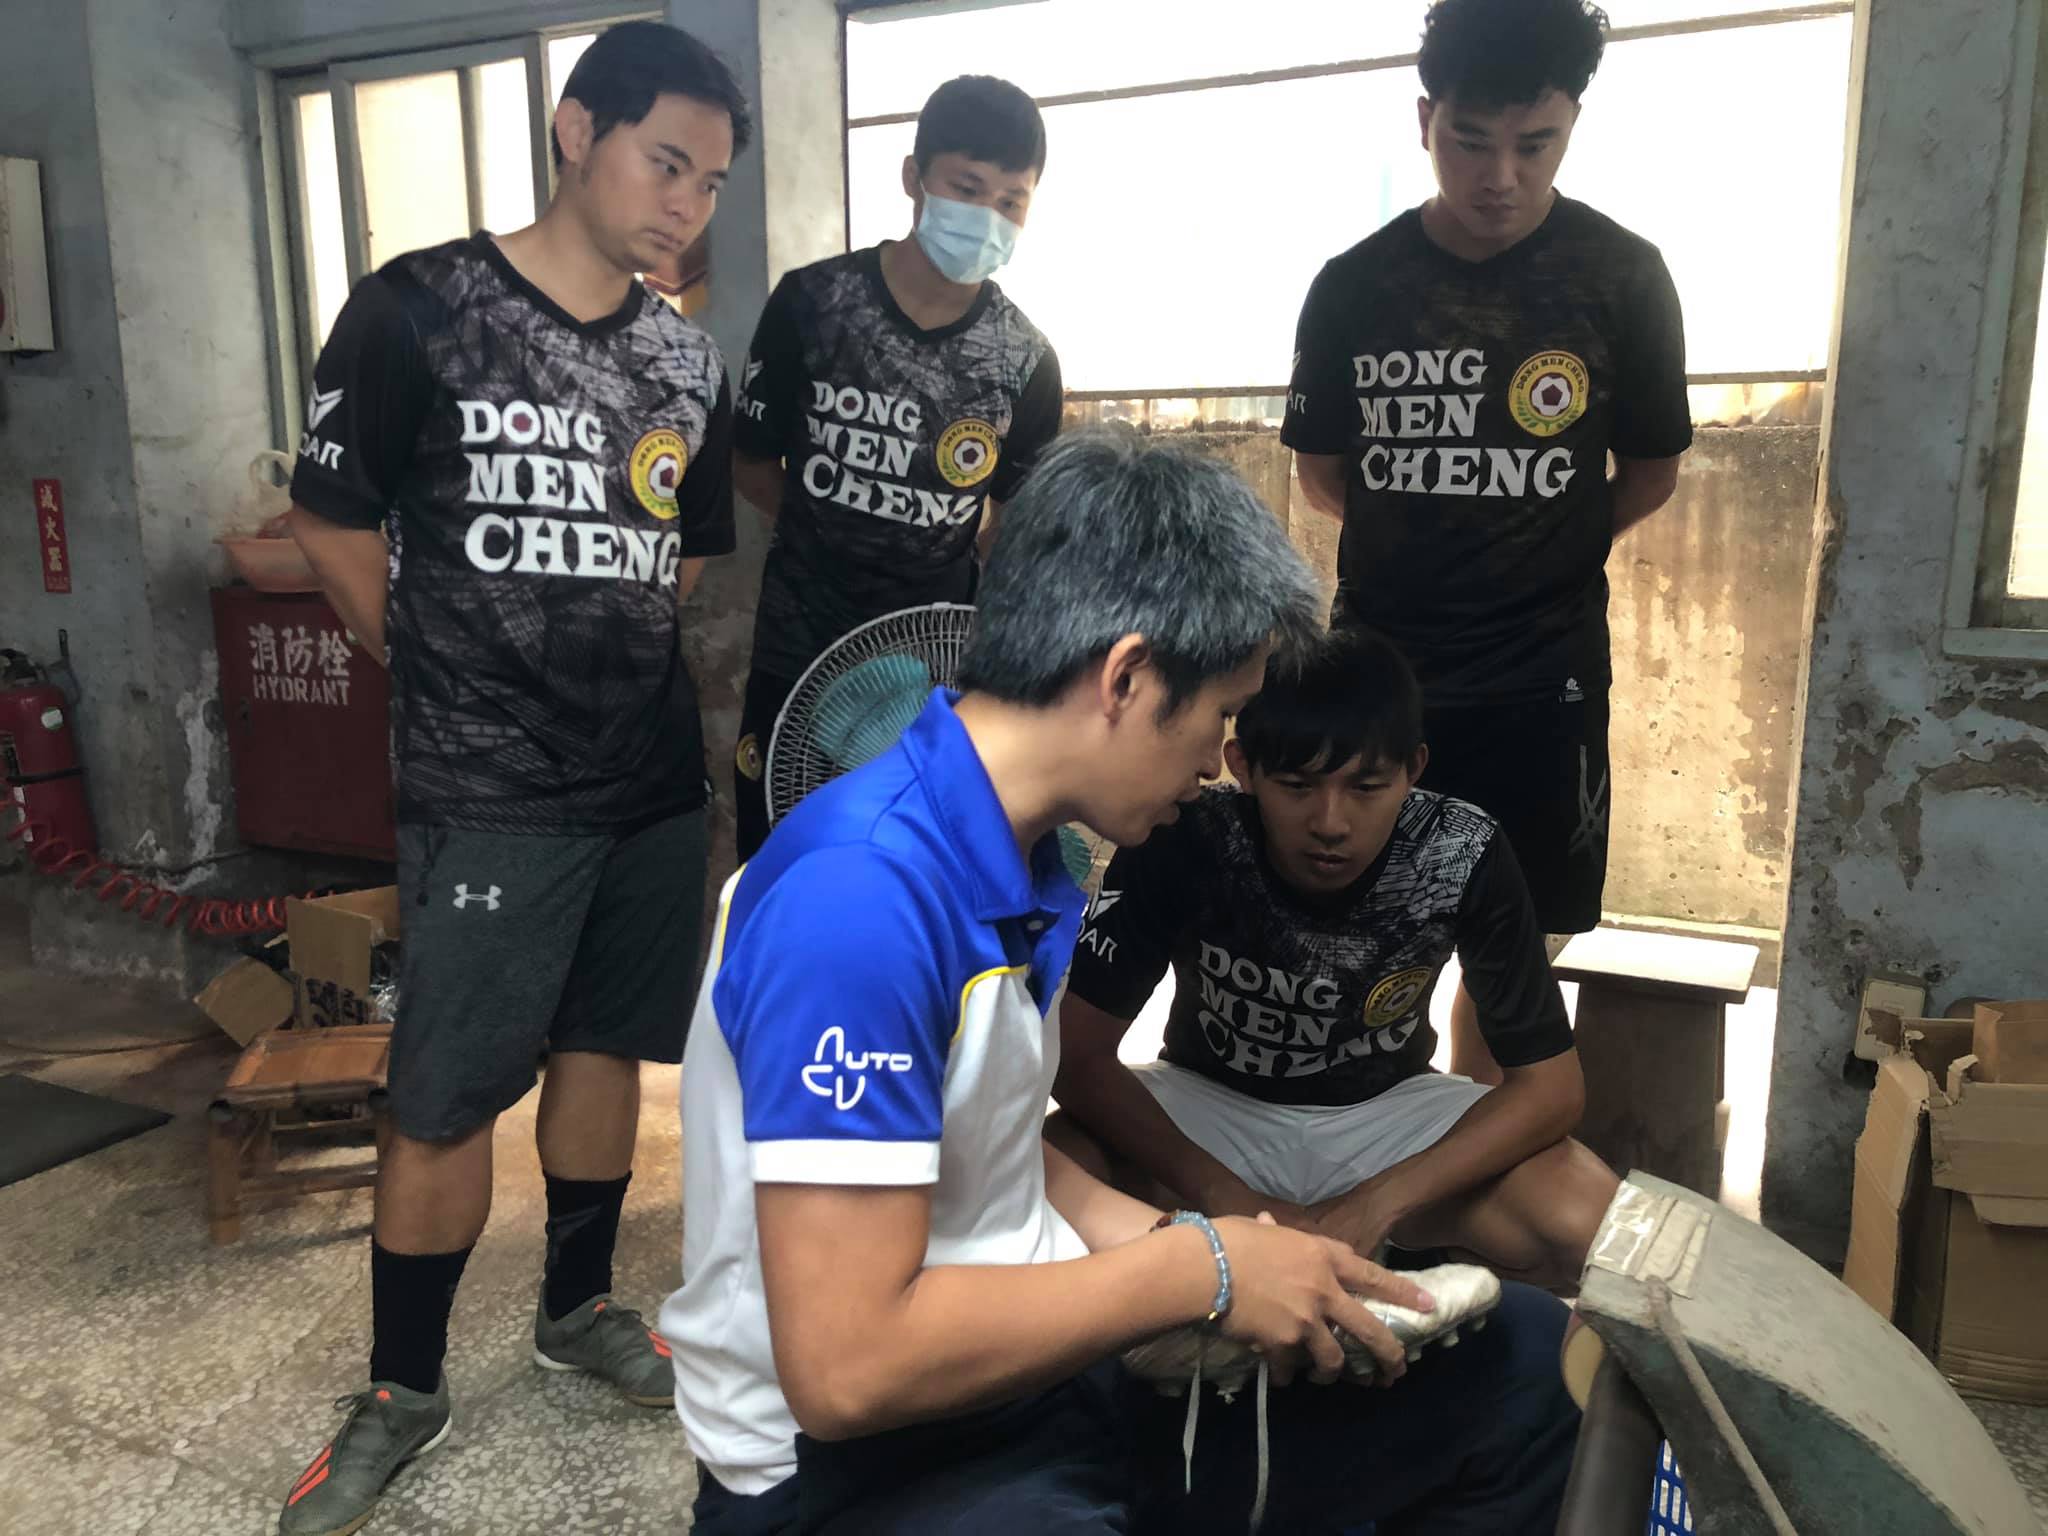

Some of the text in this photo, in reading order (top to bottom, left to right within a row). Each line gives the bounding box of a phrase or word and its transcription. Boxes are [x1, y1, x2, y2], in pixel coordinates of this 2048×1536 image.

[1353, 348, 1488, 390] DONG
[1516, 362, 1539, 390] DONG
[1541, 357, 1565, 367] MEN
[456, 400, 607, 453] DONG
[811, 380, 923, 434] DONG
[1358, 393, 1486, 439] MEN
[806, 414, 919, 478] MEN
[1360, 443, 1577, 499] CHENG
[464, 453, 607, 513] MEN
[802, 453, 979, 527] CHENG
[464, 513, 683, 586] CHENG
[247, 622, 353, 677] 消防栓
[252, 674, 351, 706] HYDRANT
[1199, 940, 1343, 1010] DONG
[1200, 970, 1337, 1047] MEN
